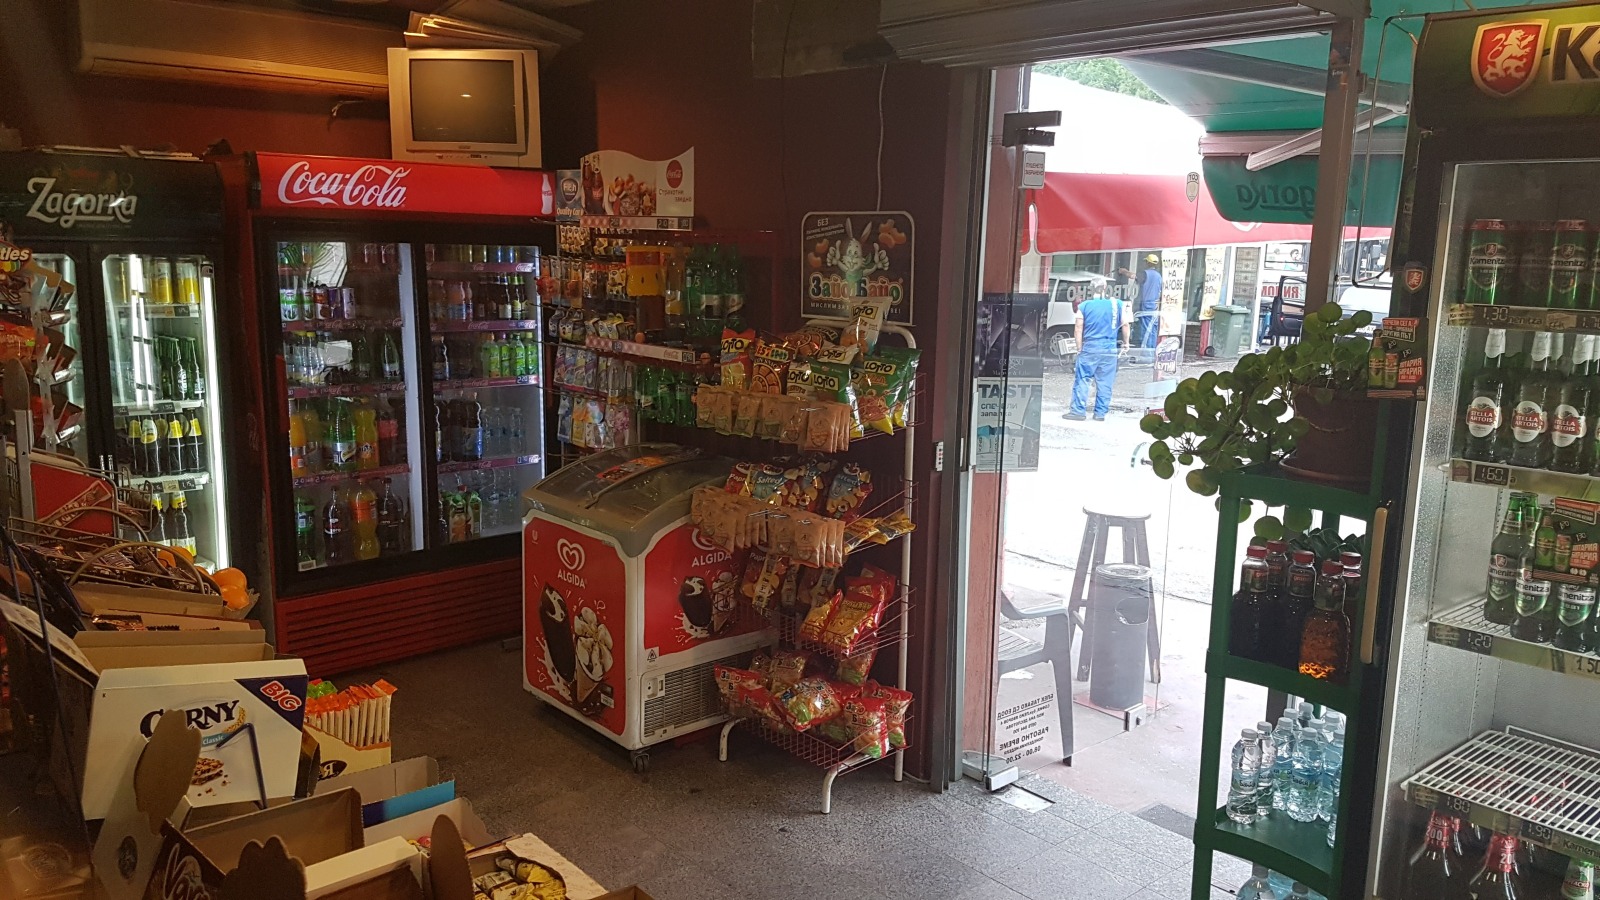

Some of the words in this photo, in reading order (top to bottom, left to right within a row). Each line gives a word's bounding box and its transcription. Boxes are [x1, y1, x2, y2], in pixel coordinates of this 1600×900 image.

[1552, 25, 1600, 81] K
[278, 161, 411, 208] Coca-Cola
[26, 176, 138, 229] Zagorka
[557, 207, 573, 218] Quality
[1483, 306, 1508, 321] 1.30
[721, 338, 745, 353] LOTTO
[864, 362, 892, 373] LOTTO
[814, 374, 836, 388] LOTTO
[1470, 410, 1493, 418] STELLA
[1554, 419, 1575, 427] STELLA
[729, 473, 746, 482] Papr
[756, 476, 782, 484] Salted
[1480, 467, 1504, 481] 1.60
[691, 550, 732, 568] ALGIDA
[750, 552, 766, 562] Papr
[557, 570, 586, 589] ALGIDA
[1516, 581, 1550, 592] amenitza
[1467, 632, 1492, 648] 1.20
[260, 680, 302, 712] BIG
[140, 700, 240, 737] CRNY
[202, 734, 224, 746] Classic
[1446, 797, 1470, 813] 1.80
[1528, 823, 1552, 840] 1.90
